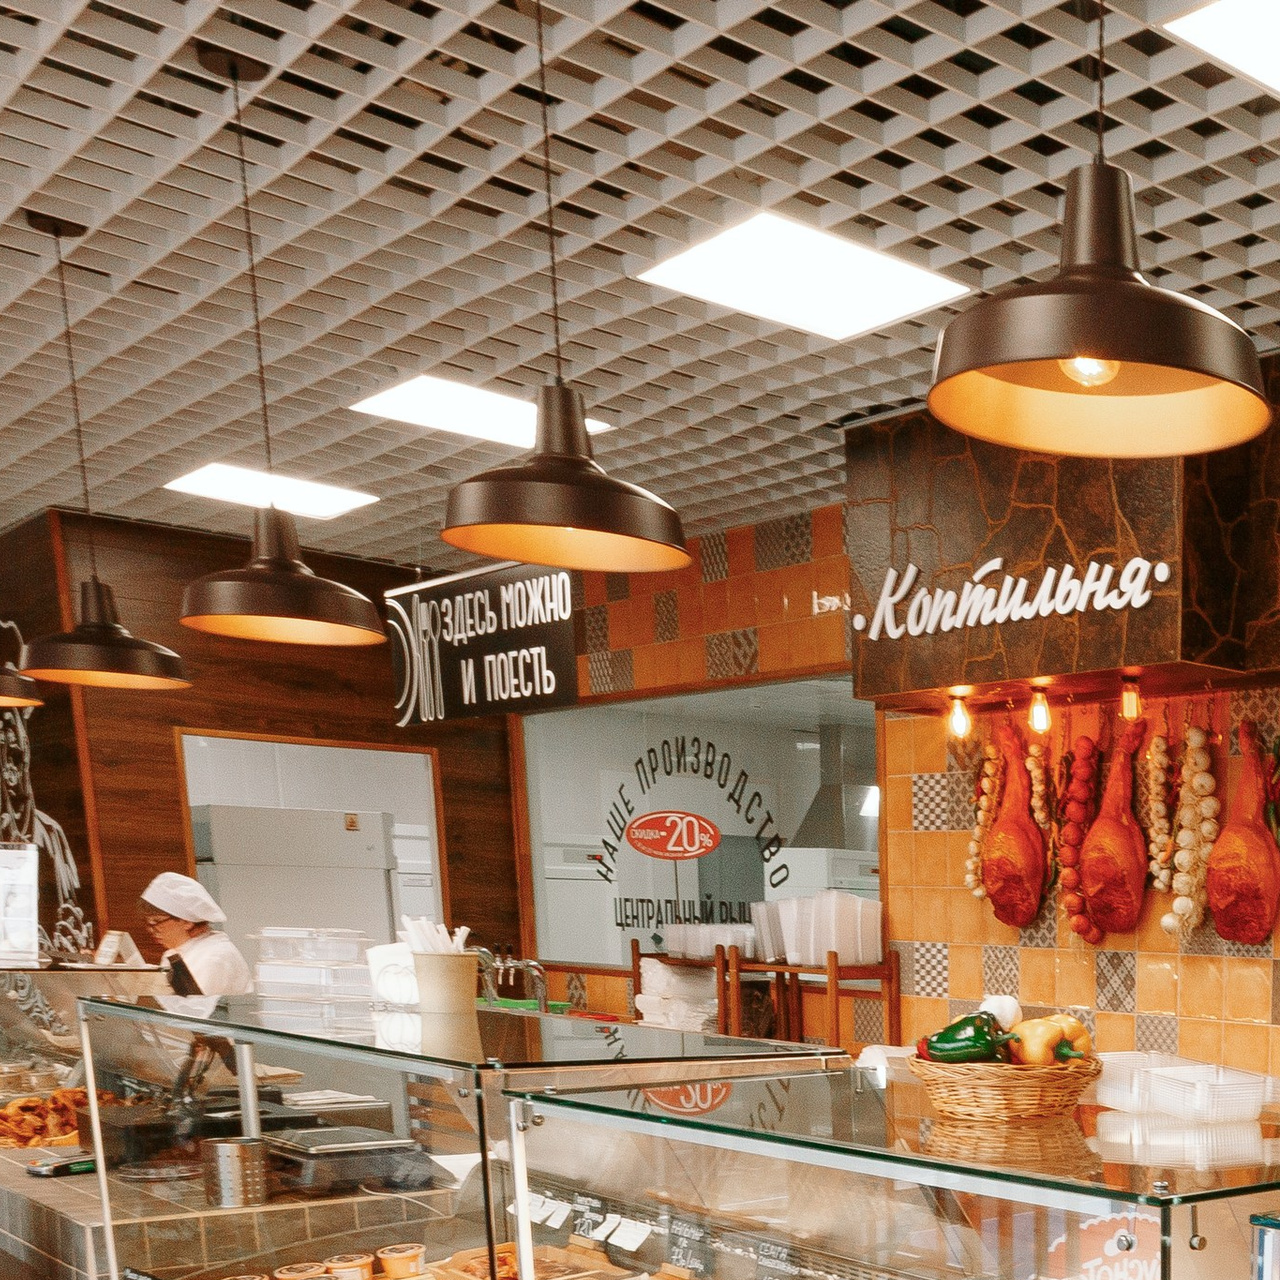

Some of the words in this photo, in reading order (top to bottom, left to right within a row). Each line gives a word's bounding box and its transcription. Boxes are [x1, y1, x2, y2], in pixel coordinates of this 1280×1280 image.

[441, 589, 497, 647] ЗДЕСЬ
[500, 571, 571, 630] МОЖНО
[868, 556, 1152, 641] Коптильня
[461, 658, 477, 705] И
[484, 646, 556, 702] ПОЕСТЬ
[597, 784, 635, 884] НАШЕ
[635, 736, 789, 888] ПРОИЗВОДСТВО
[719, 900, 752, 924] РЫН
